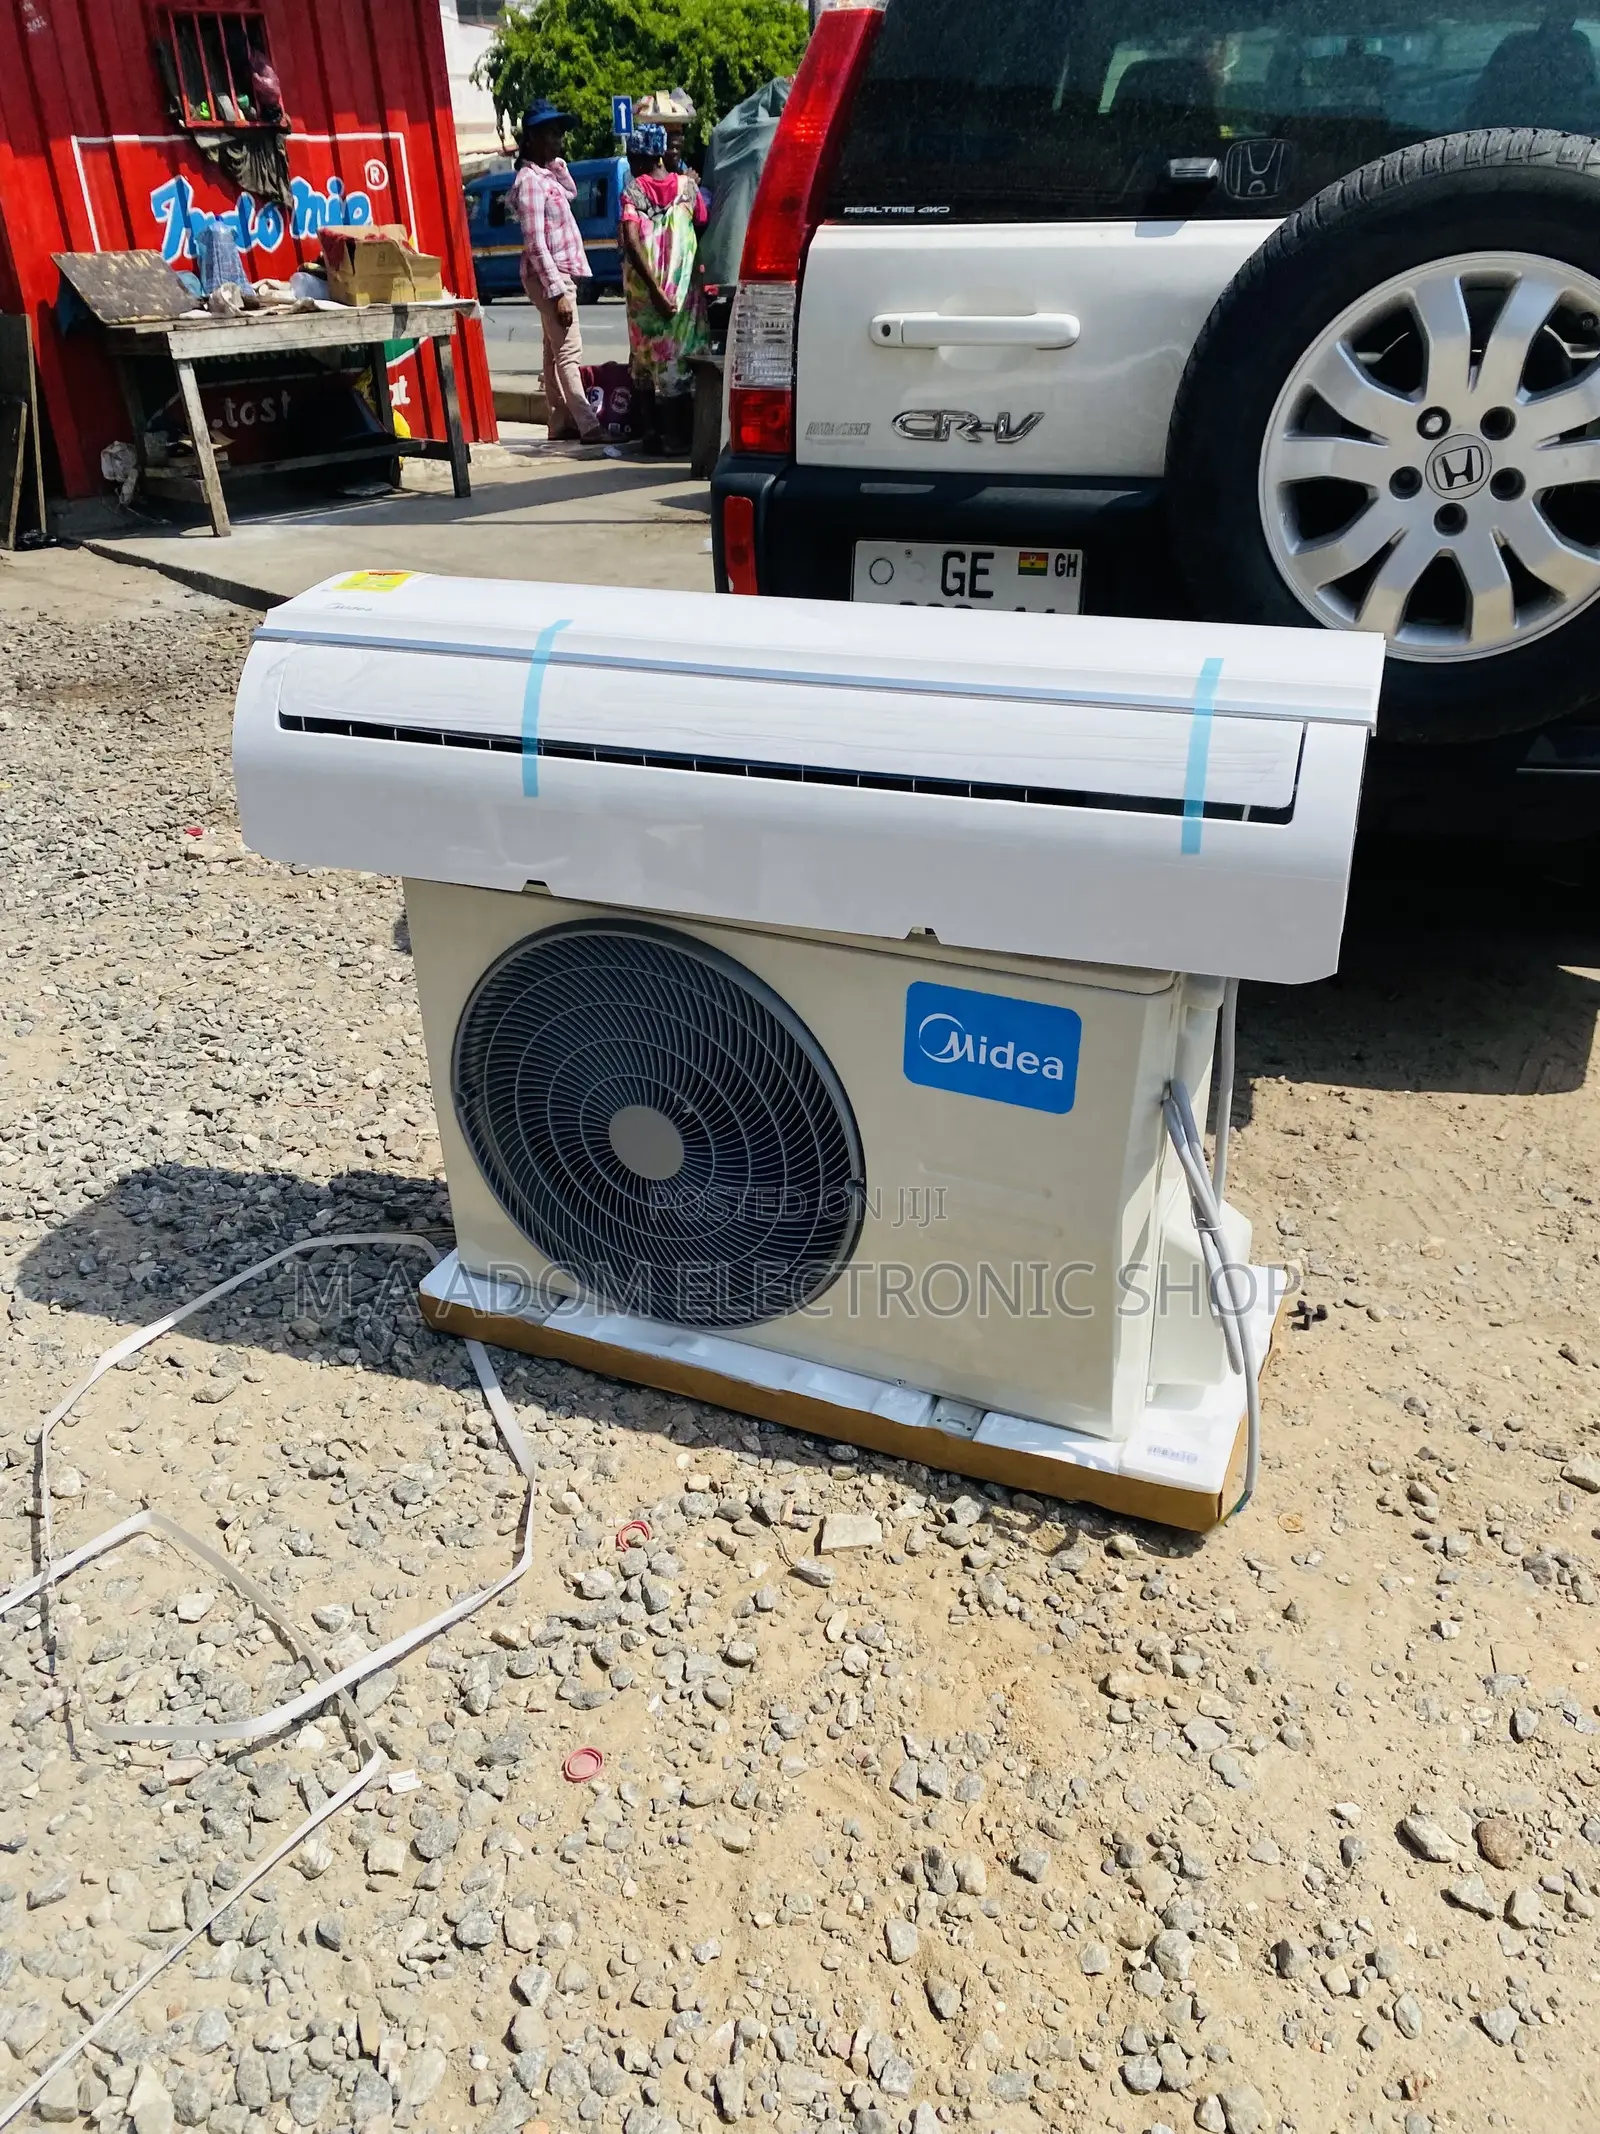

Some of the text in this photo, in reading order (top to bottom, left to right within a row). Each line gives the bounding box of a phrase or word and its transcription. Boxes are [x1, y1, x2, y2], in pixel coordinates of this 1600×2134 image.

[891, 409, 1045, 444] CR-V
[940, 550, 995, 599] GE
[1054, 552, 1078, 578] GH
[923, 1018, 1064, 1081] Midea
